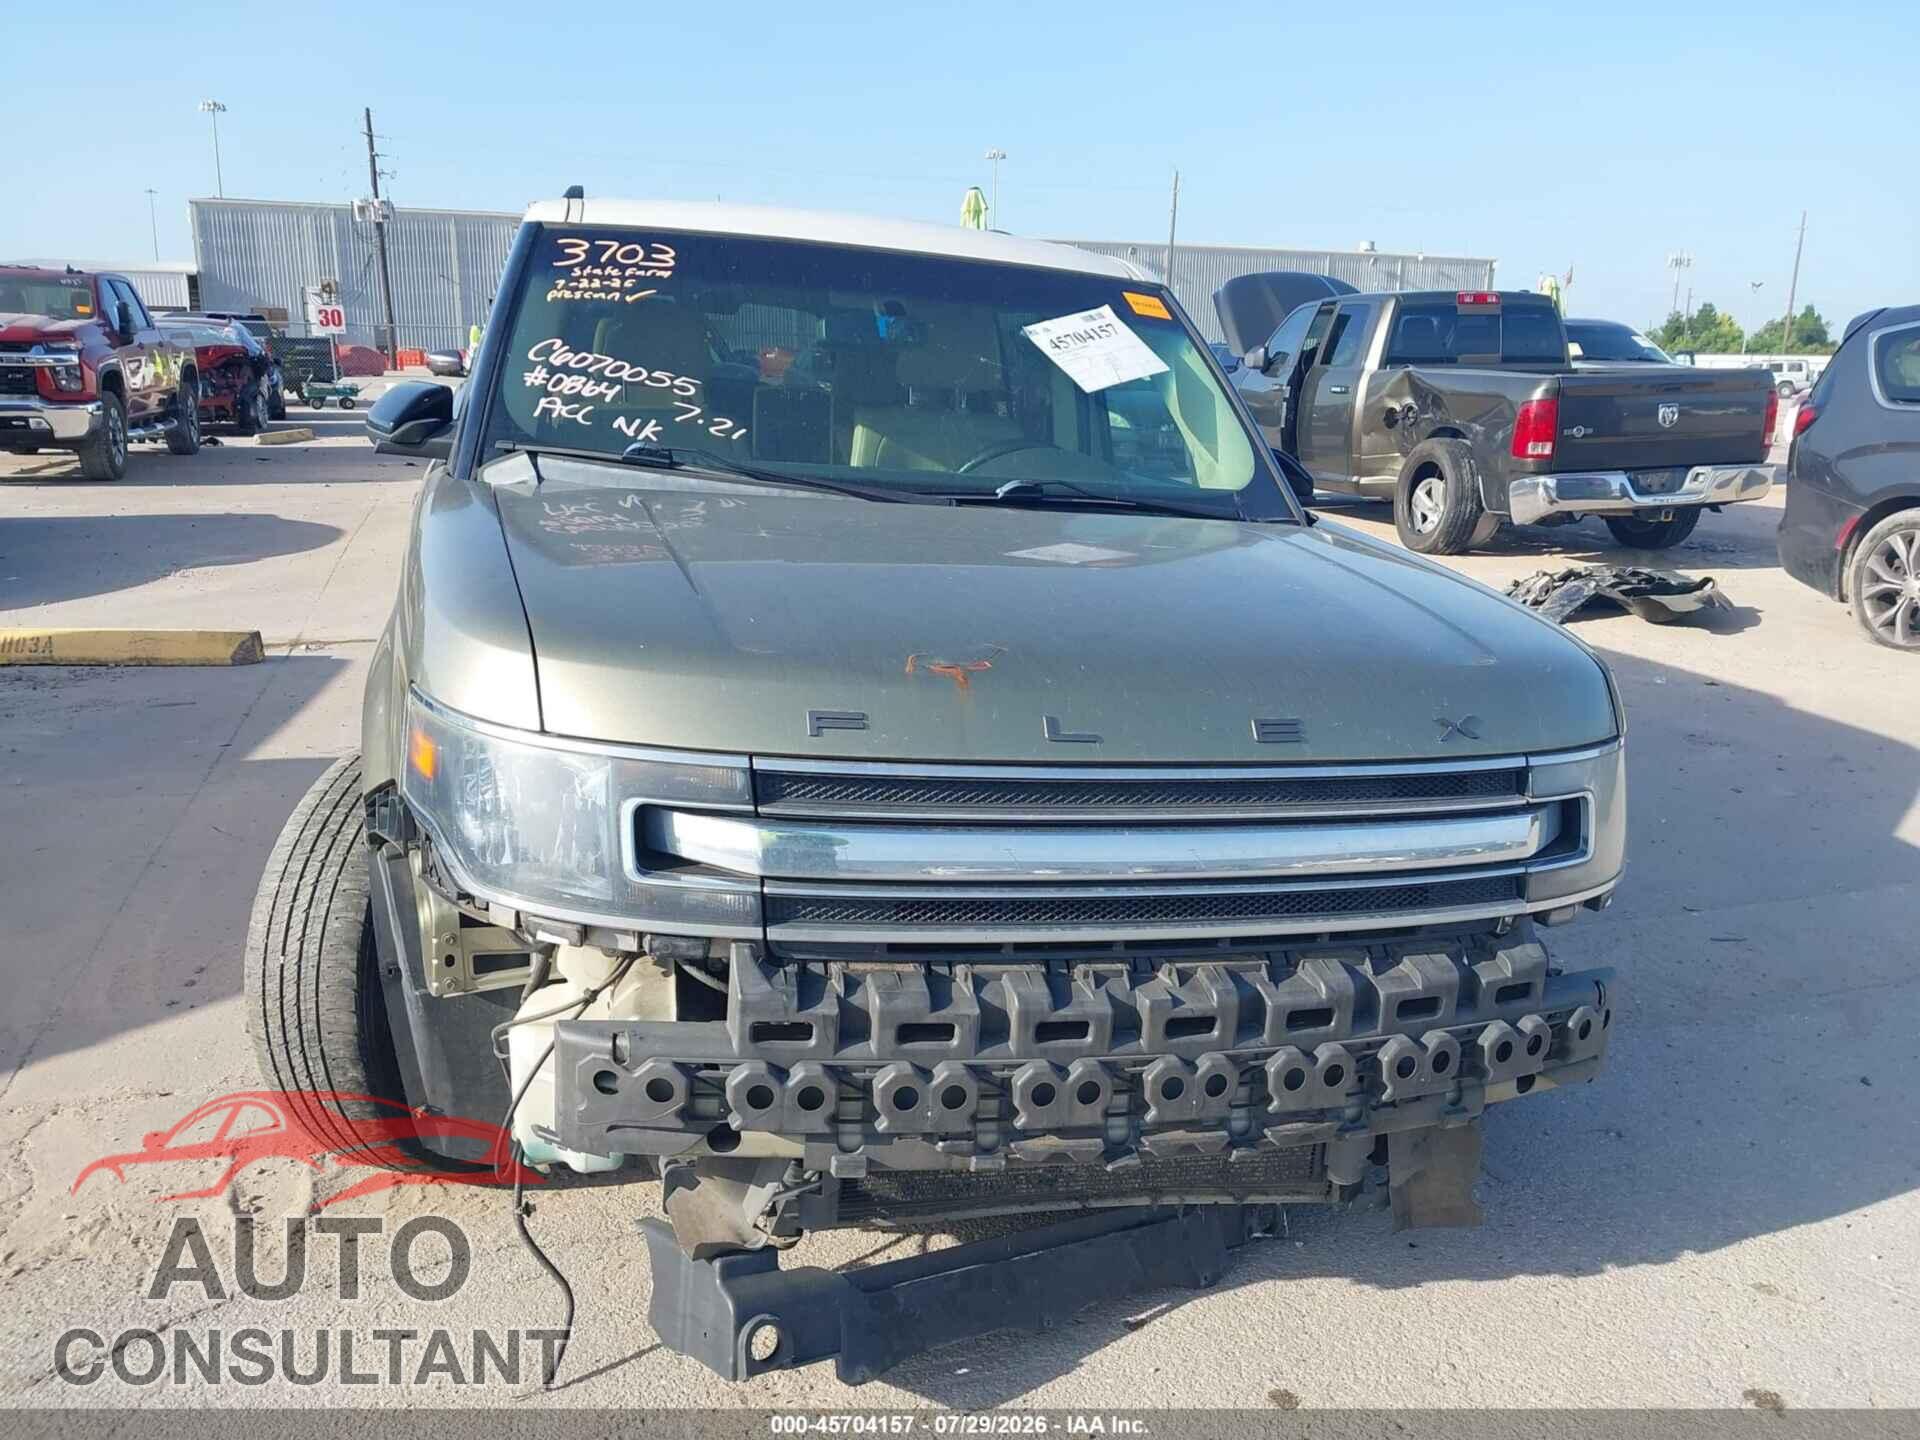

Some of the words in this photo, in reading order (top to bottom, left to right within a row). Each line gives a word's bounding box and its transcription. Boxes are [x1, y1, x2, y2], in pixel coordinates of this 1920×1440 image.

[552, 238, 676, 267] 3703
[318, 309, 342, 327] 30
[1049, 322, 1118, 350] 45704157
[527, 338, 702, 396] C6070055
[612, 415, 663, 442] NK
[806, 710, 1483, 744] FLEX
